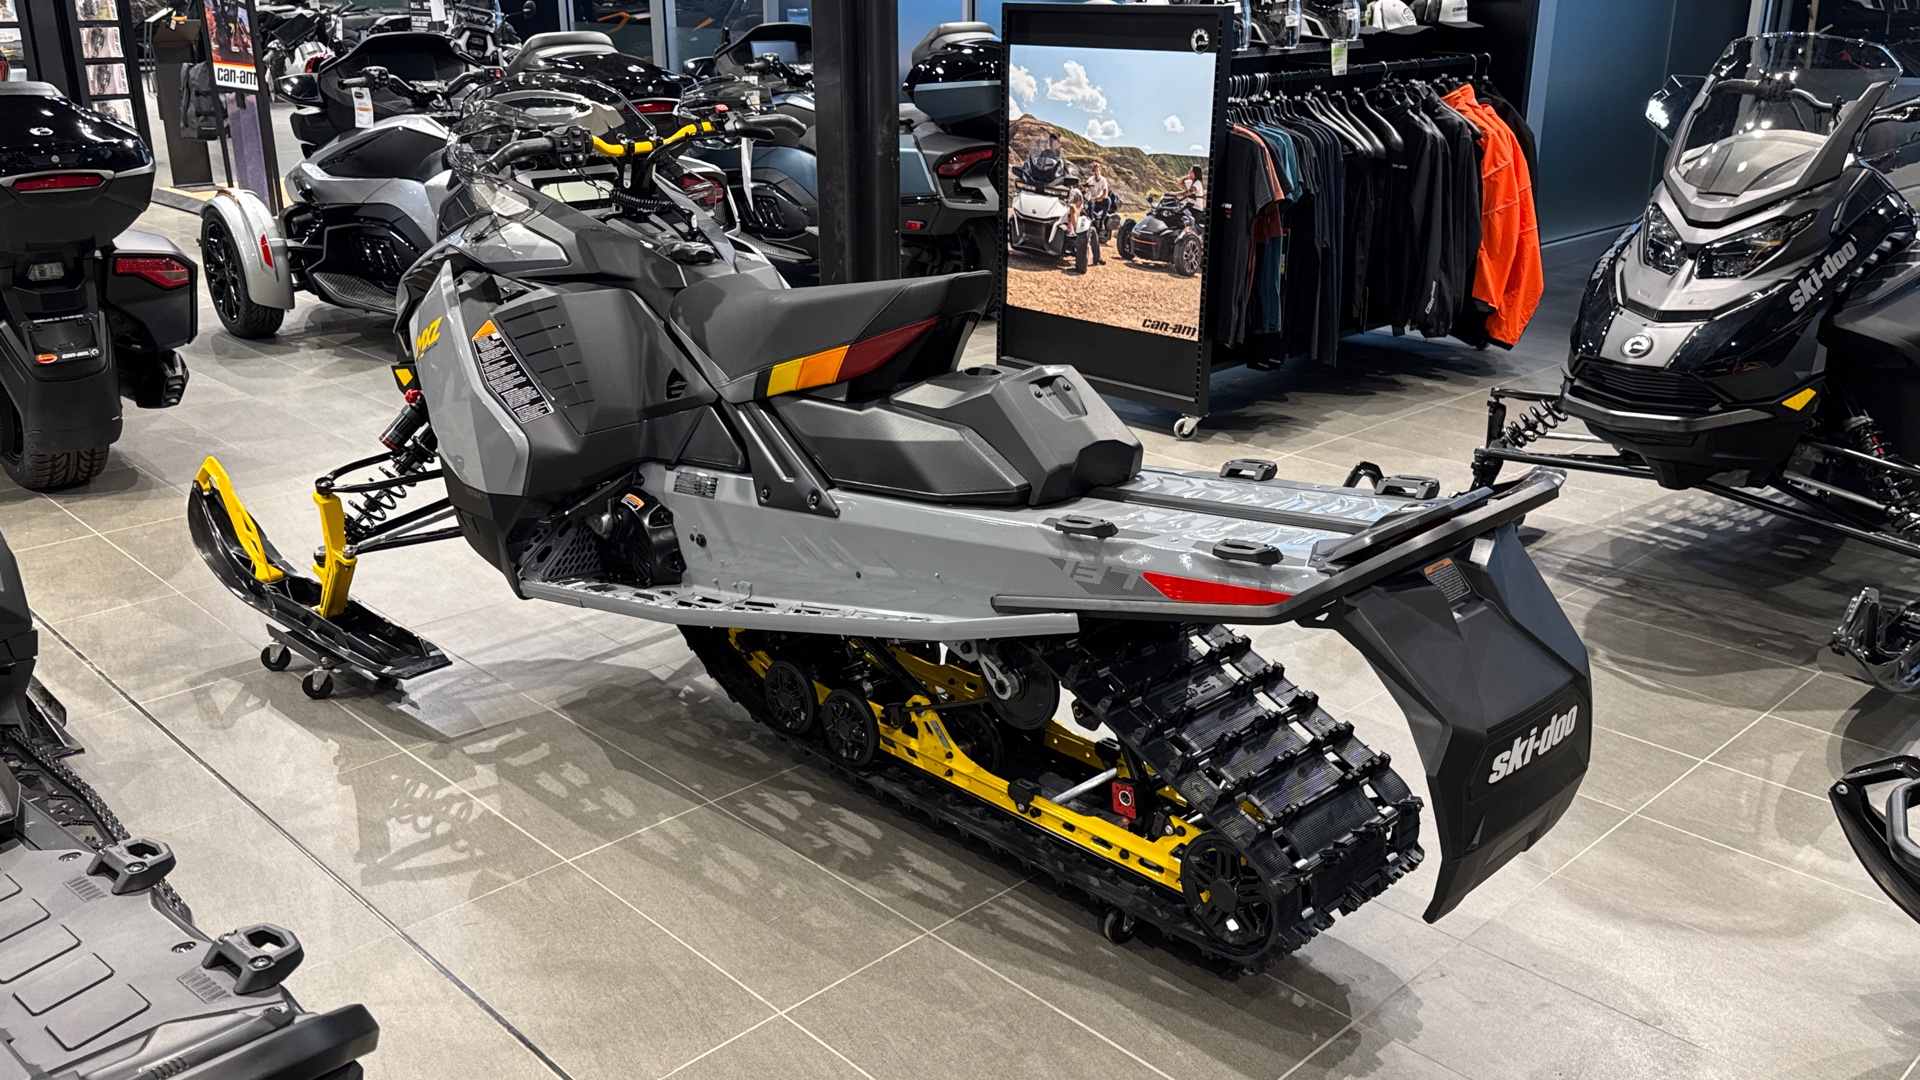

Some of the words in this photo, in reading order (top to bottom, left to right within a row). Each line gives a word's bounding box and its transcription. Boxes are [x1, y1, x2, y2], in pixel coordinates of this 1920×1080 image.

[217, 67, 257, 85] can-am
[1789, 241, 1858, 312] ski-doo
[416, 316, 443, 359] MXZ
[1142, 319, 1197, 337] can-am
[1488, 705, 1578, 784] ski-doo
